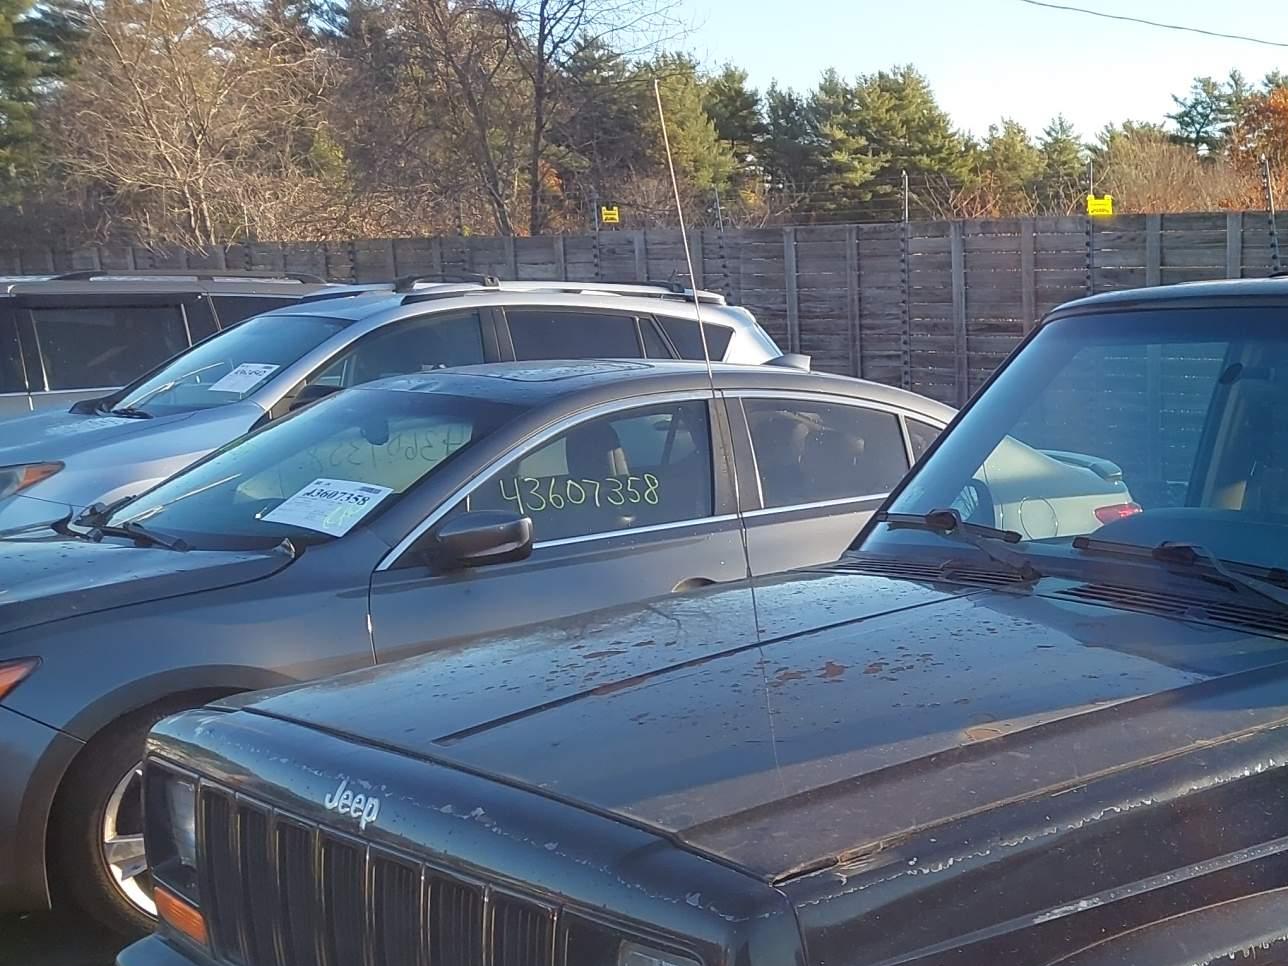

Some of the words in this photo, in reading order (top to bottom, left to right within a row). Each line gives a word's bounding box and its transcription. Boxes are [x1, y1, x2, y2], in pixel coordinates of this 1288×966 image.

[302, 487, 371, 507] 43607358
[499, 473, 659, 514] 43607358
[324, 778, 380, 830] Jeep
